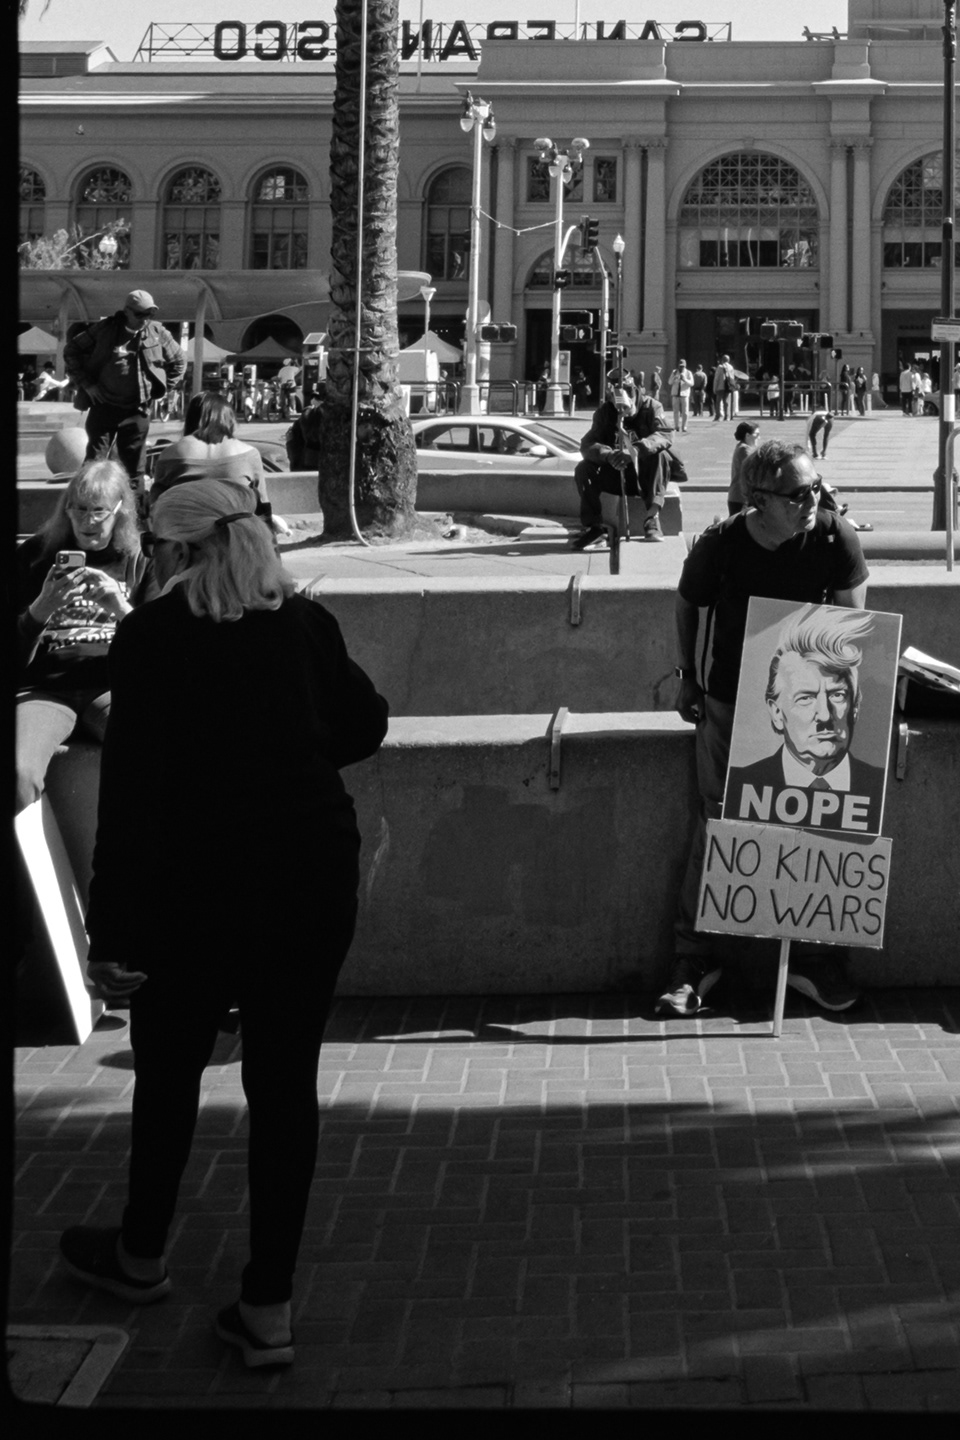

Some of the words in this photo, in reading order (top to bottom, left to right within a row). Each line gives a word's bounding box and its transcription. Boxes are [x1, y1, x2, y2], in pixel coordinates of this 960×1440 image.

[738, 783, 871, 831] NOPE
[707, 834, 761, 877] NO
[775, 844, 886, 891] KINGS
[701, 882, 757, 923] NO
[770, 888, 882, 936] WARS
